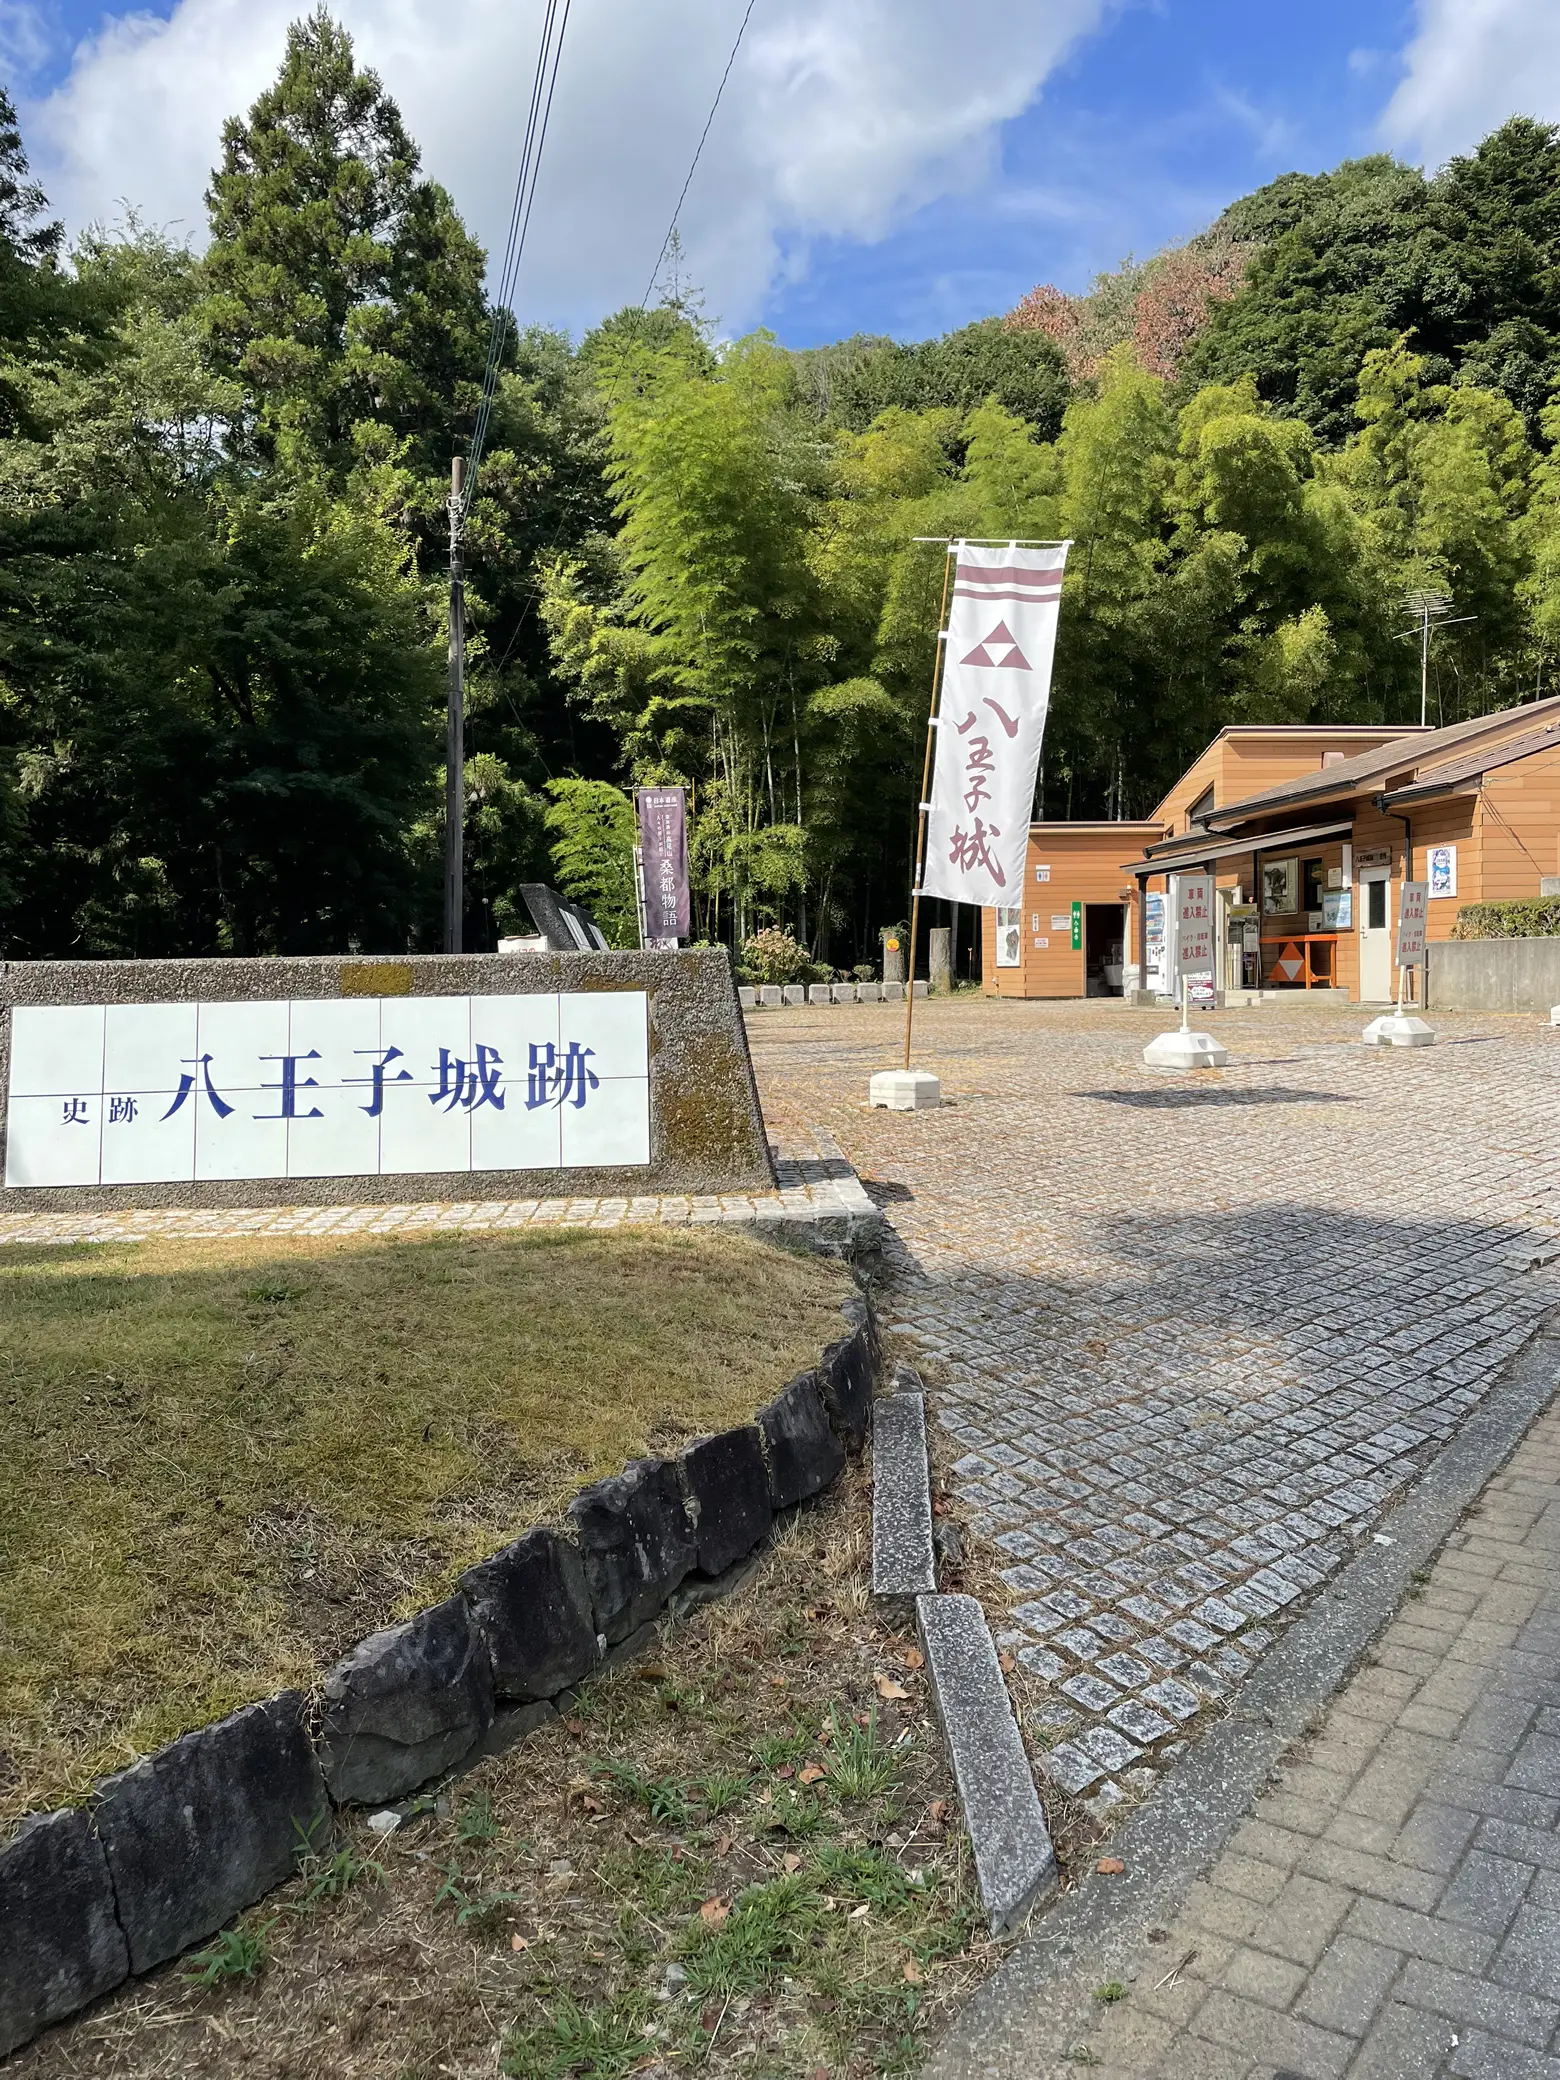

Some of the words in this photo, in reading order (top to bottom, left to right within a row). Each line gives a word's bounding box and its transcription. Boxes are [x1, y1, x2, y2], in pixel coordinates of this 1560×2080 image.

[949, 697, 1020, 888] 八王子城
[659, 859, 678, 926] 桑都物語
[1182, 905, 1208, 919] 進入禁止
[1404, 907, 1424, 919] 進入禁止
[1182, 944, 1208, 960] 進入禁止
[1401, 940, 1421, 953] 進入禁止
[61, 1096, 139, 1125] 史跡
[159, 1041, 600, 1122] 八王子城跡
